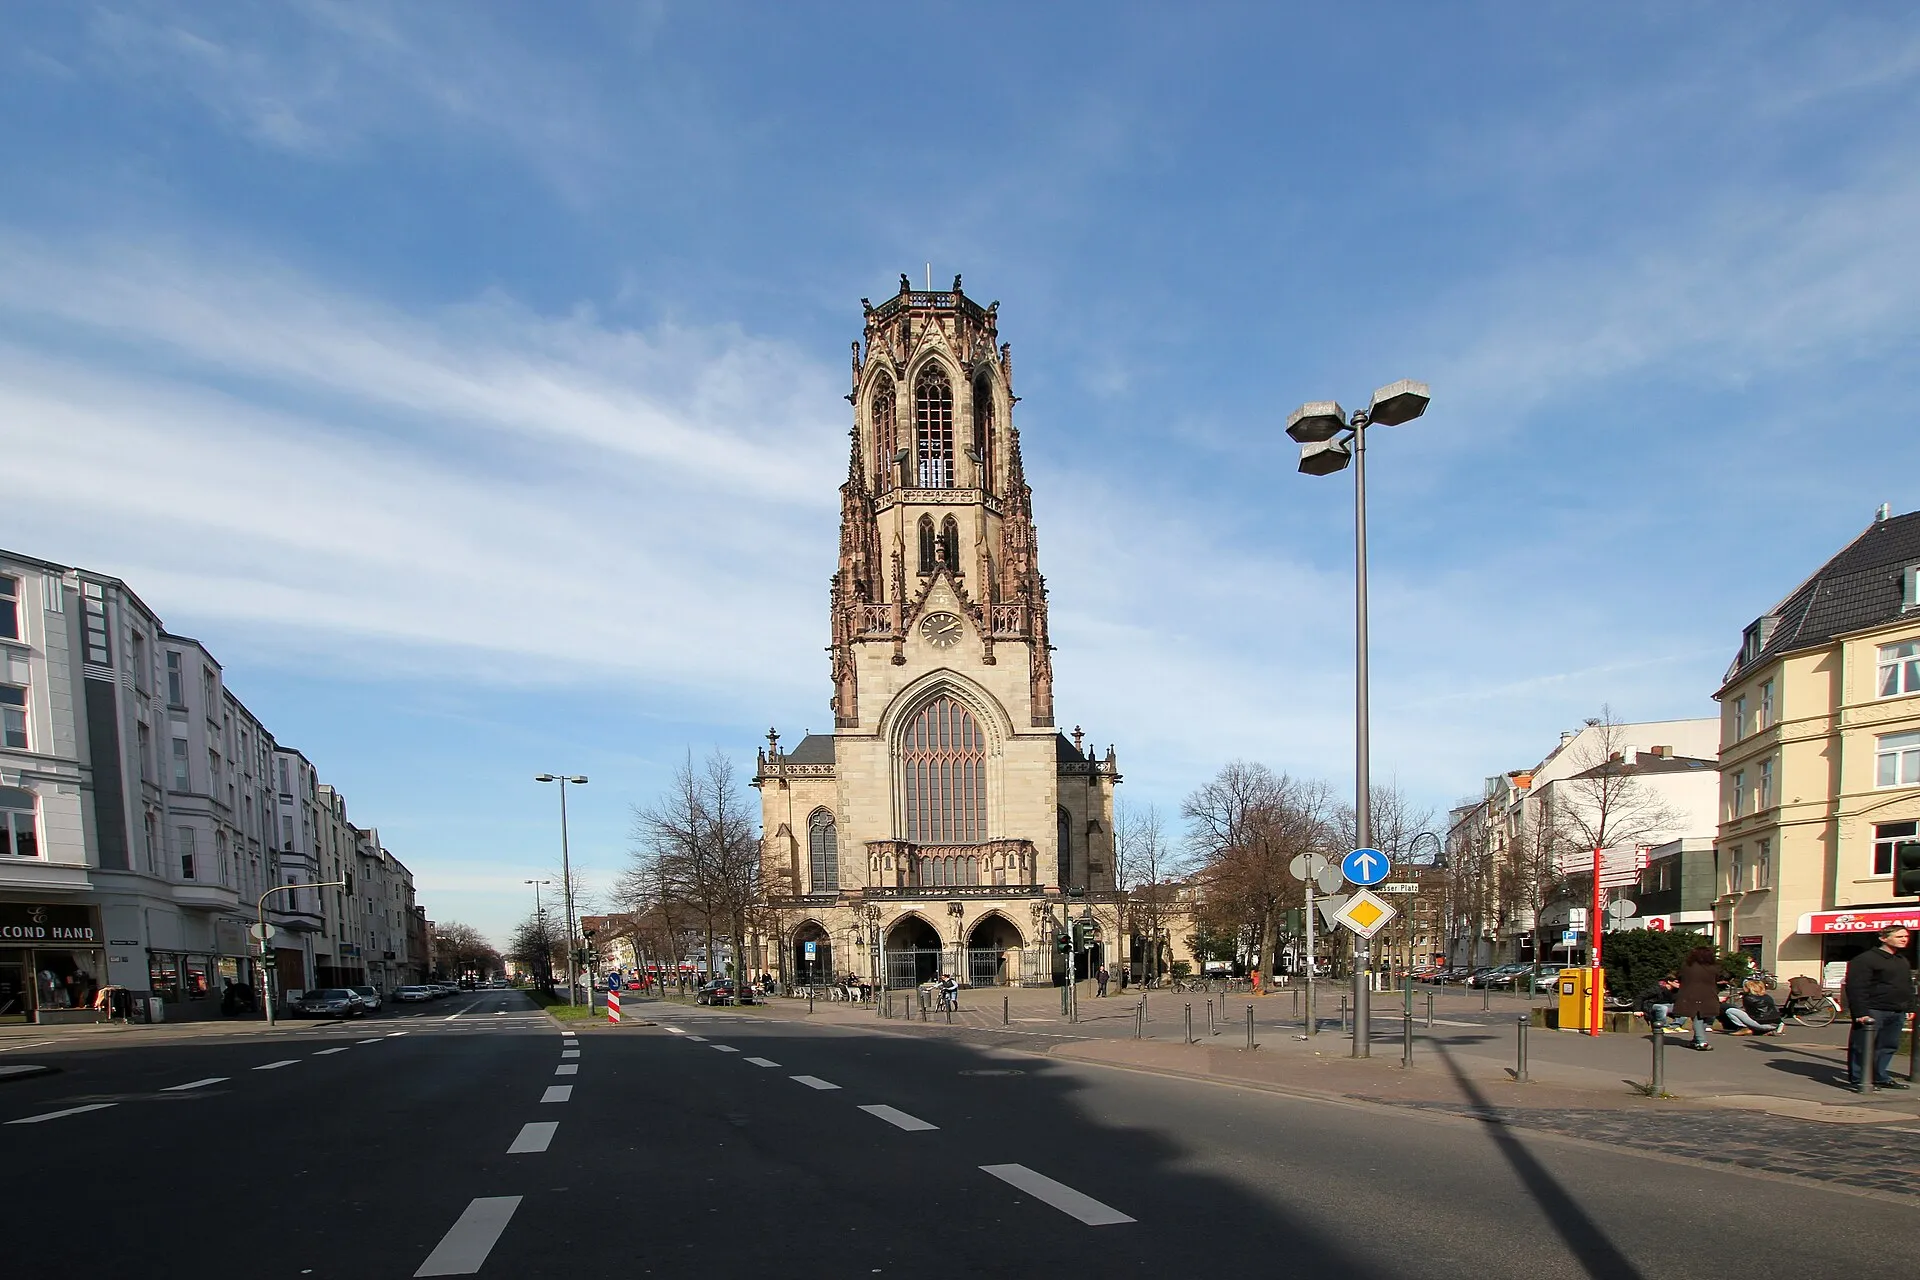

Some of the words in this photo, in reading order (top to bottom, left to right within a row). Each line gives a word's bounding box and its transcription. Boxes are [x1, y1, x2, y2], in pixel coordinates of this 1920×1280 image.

[1400, 884, 1418, 892] Platz
[1824, 919, 1919, 931] FOTO-TEAM
[0, 926, 46, 938] COND
[53, 927, 94, 939] HAND
